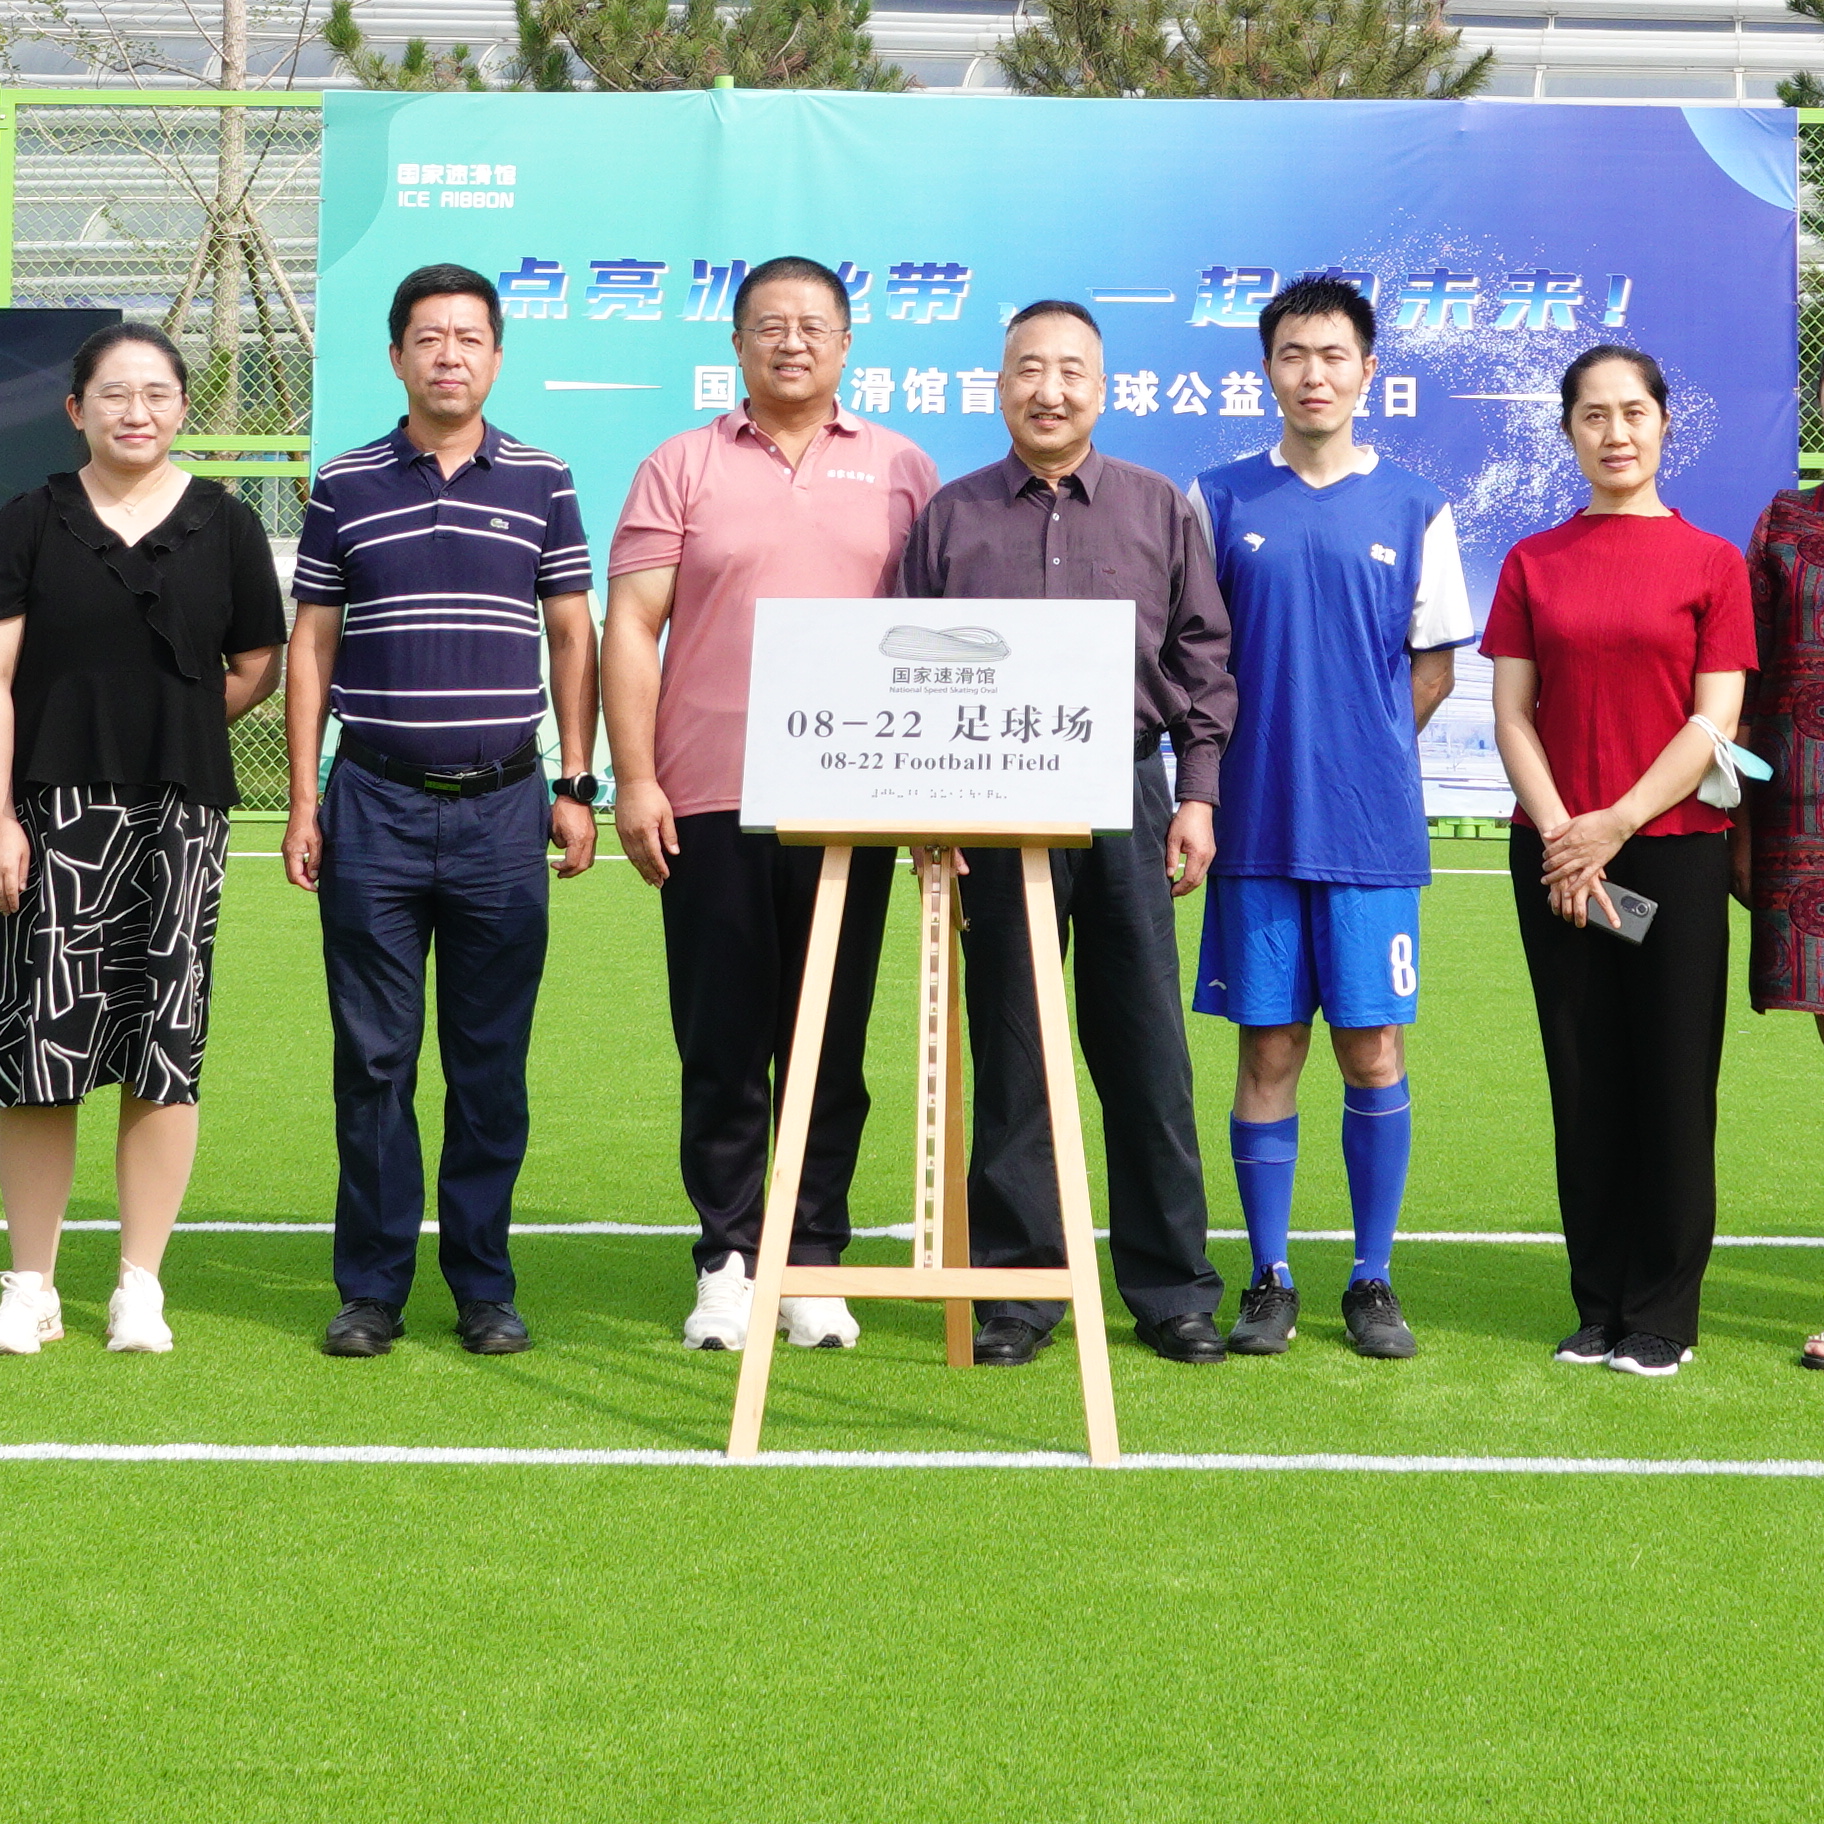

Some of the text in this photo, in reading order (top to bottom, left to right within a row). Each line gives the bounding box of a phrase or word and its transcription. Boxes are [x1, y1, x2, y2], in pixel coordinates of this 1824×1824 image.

[396, 163, 517, 186] 国家速滑馆
[398, 190, 515, 209] ICE RIBBON
[694, 365, 1418, 418] 国滑馆盲球公益日
[892, 666, 996, 685] 国家速滑馆
[889, 686, 998, 695] National Speed Skating Oval
[787, 704, 1094, 744] 08-22 足球场
[820, 752, 1061, 772] 08-22 Football Field
[1391, 933, 1417, 997] 8
